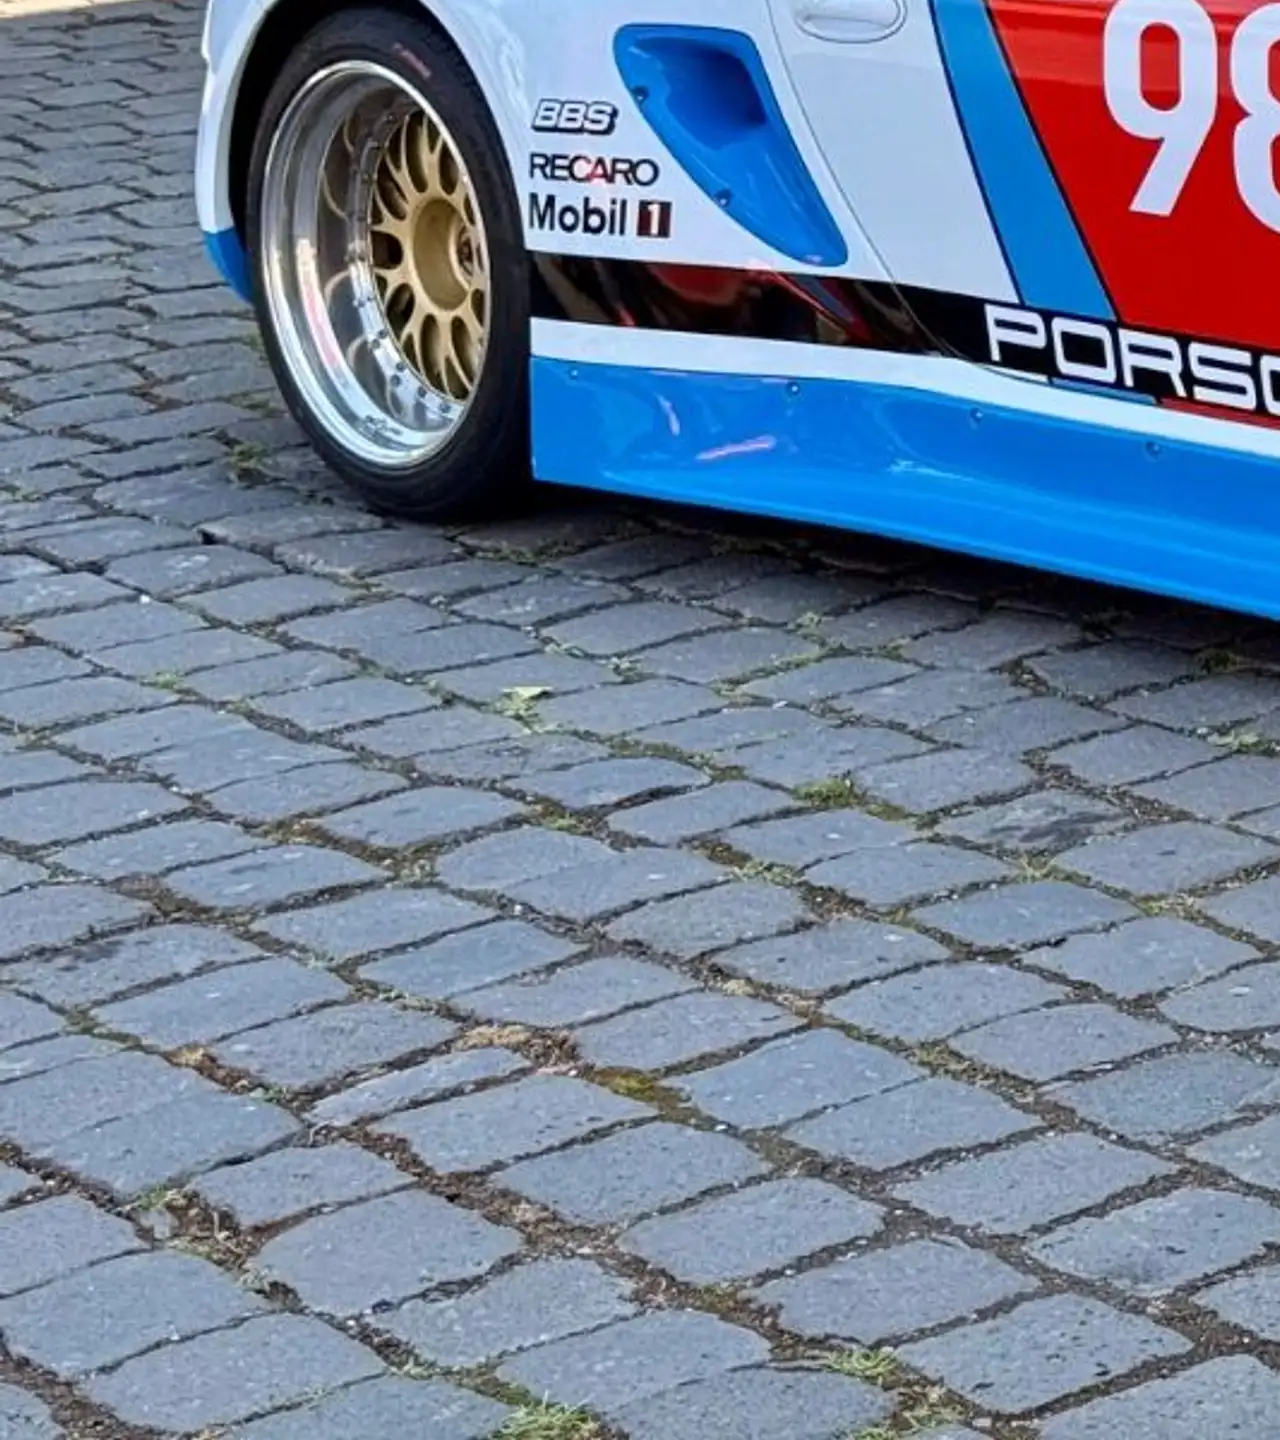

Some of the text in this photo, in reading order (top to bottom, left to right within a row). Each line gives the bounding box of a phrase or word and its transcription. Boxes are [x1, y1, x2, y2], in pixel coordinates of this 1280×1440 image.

[531, 98, 619, 136] BBS
[529, 152, 660, 187] RECARO
[529, 192, 628, 236] Mobil
